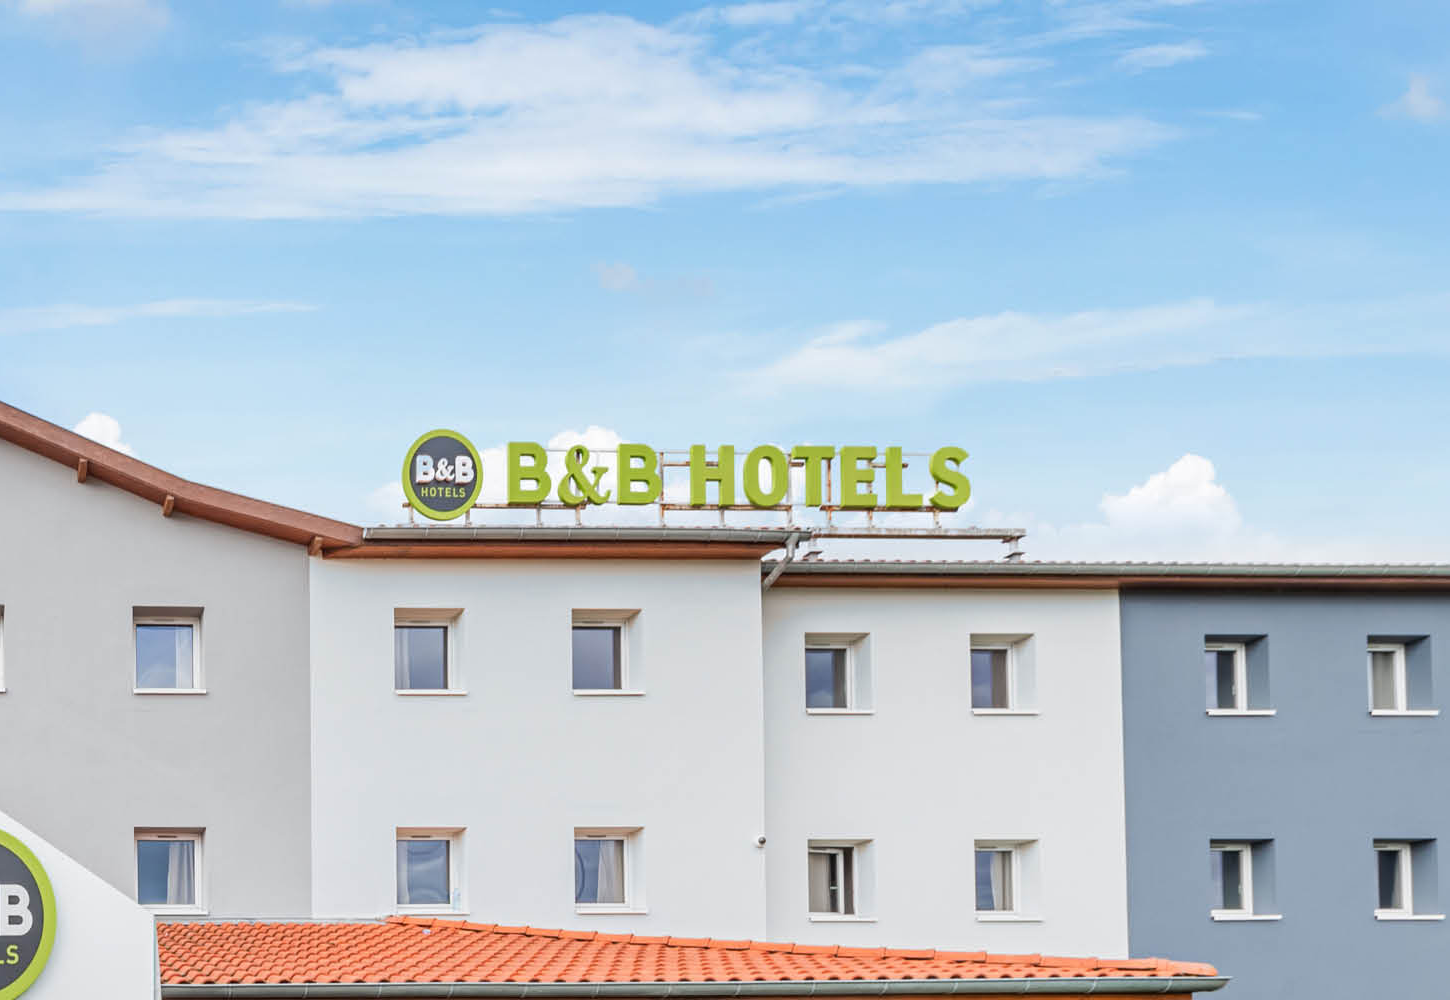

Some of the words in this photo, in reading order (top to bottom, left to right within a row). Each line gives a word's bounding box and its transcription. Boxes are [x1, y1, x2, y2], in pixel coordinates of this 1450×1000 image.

[416, 455, 474, 484] B&B
[507, 441, 663, 506] B&B
[689, 444, 972, 510] HOTELS
[421, 486, 466, 498] HOTELS
